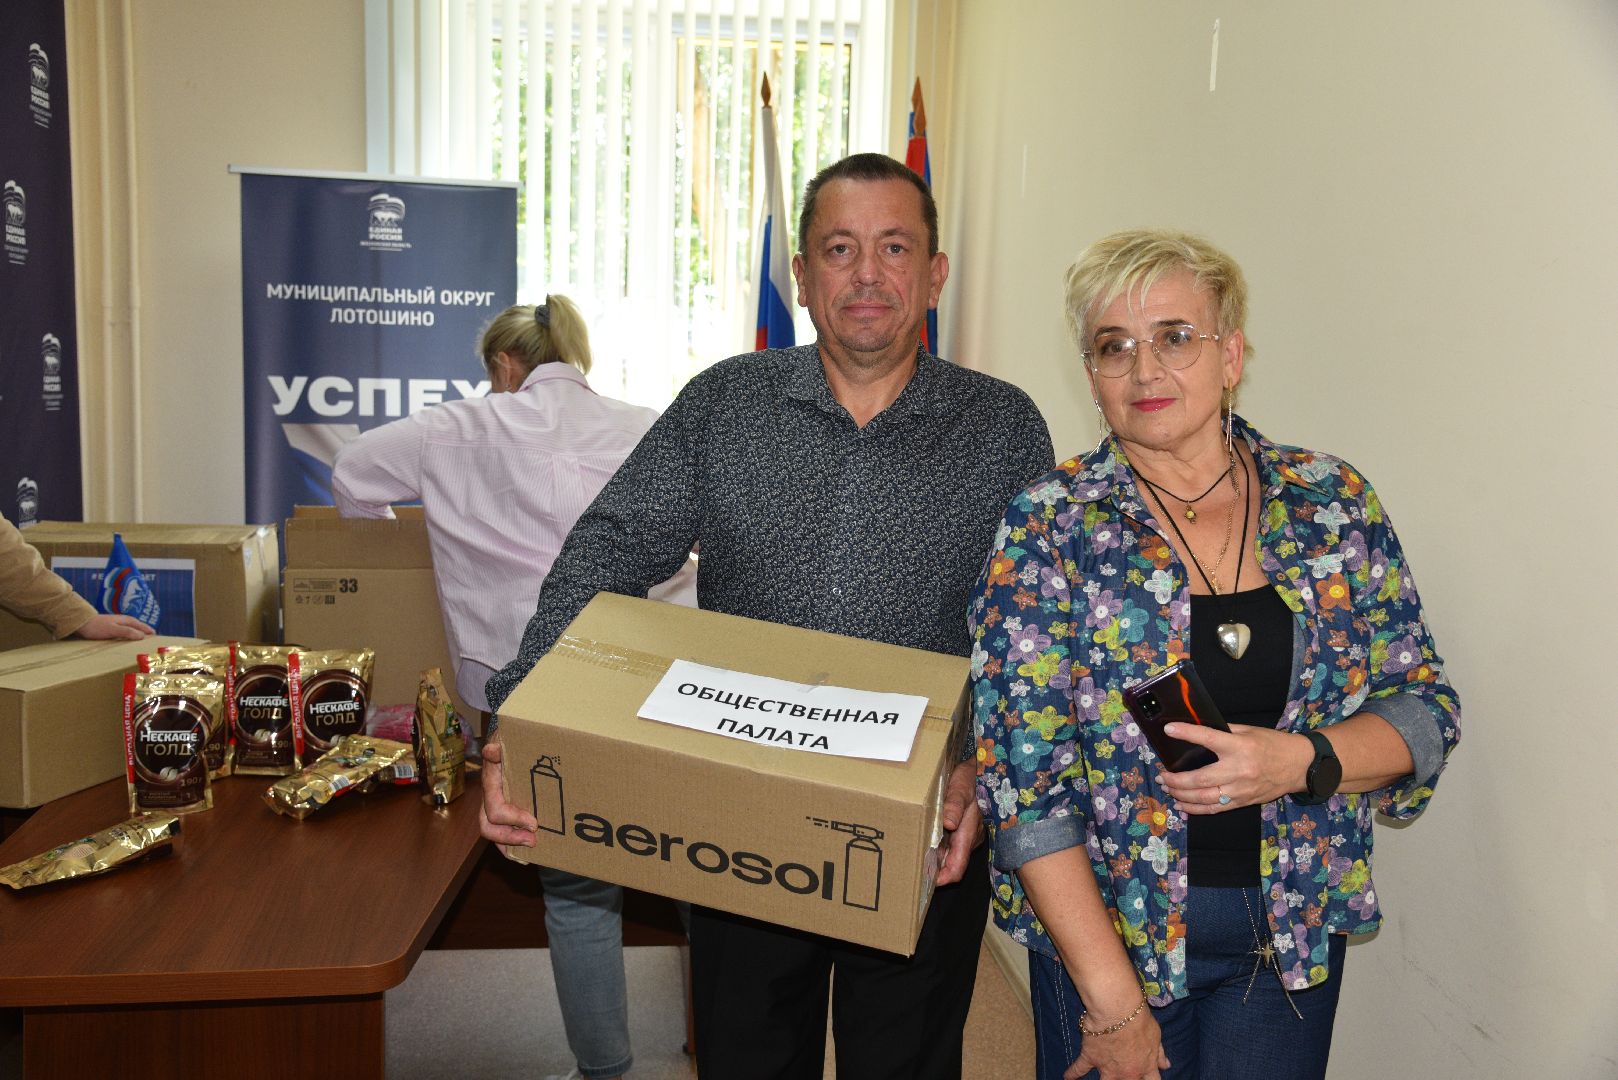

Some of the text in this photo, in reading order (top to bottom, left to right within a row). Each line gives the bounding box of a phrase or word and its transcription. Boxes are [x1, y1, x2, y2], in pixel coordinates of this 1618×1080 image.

[266, 283, 495, 307] МУНИЦИПАЛЬНЫЙ ОКРУГ
[330, 307, 435, 327] ЛОТОШИНО
[339, 577, 359, 593] 33
[677, 682, 900, 725] ОБЩЕСТВЕННАЯ
[243, 708, 284, 720] ГОЛД
[315, 712, 357, 727] ГОЛД
[716, 718, 830, 750] ПАЛАТА
[144, 743, 193, 756] ГОЛД
[574, 812, 834, 901] aerosol
